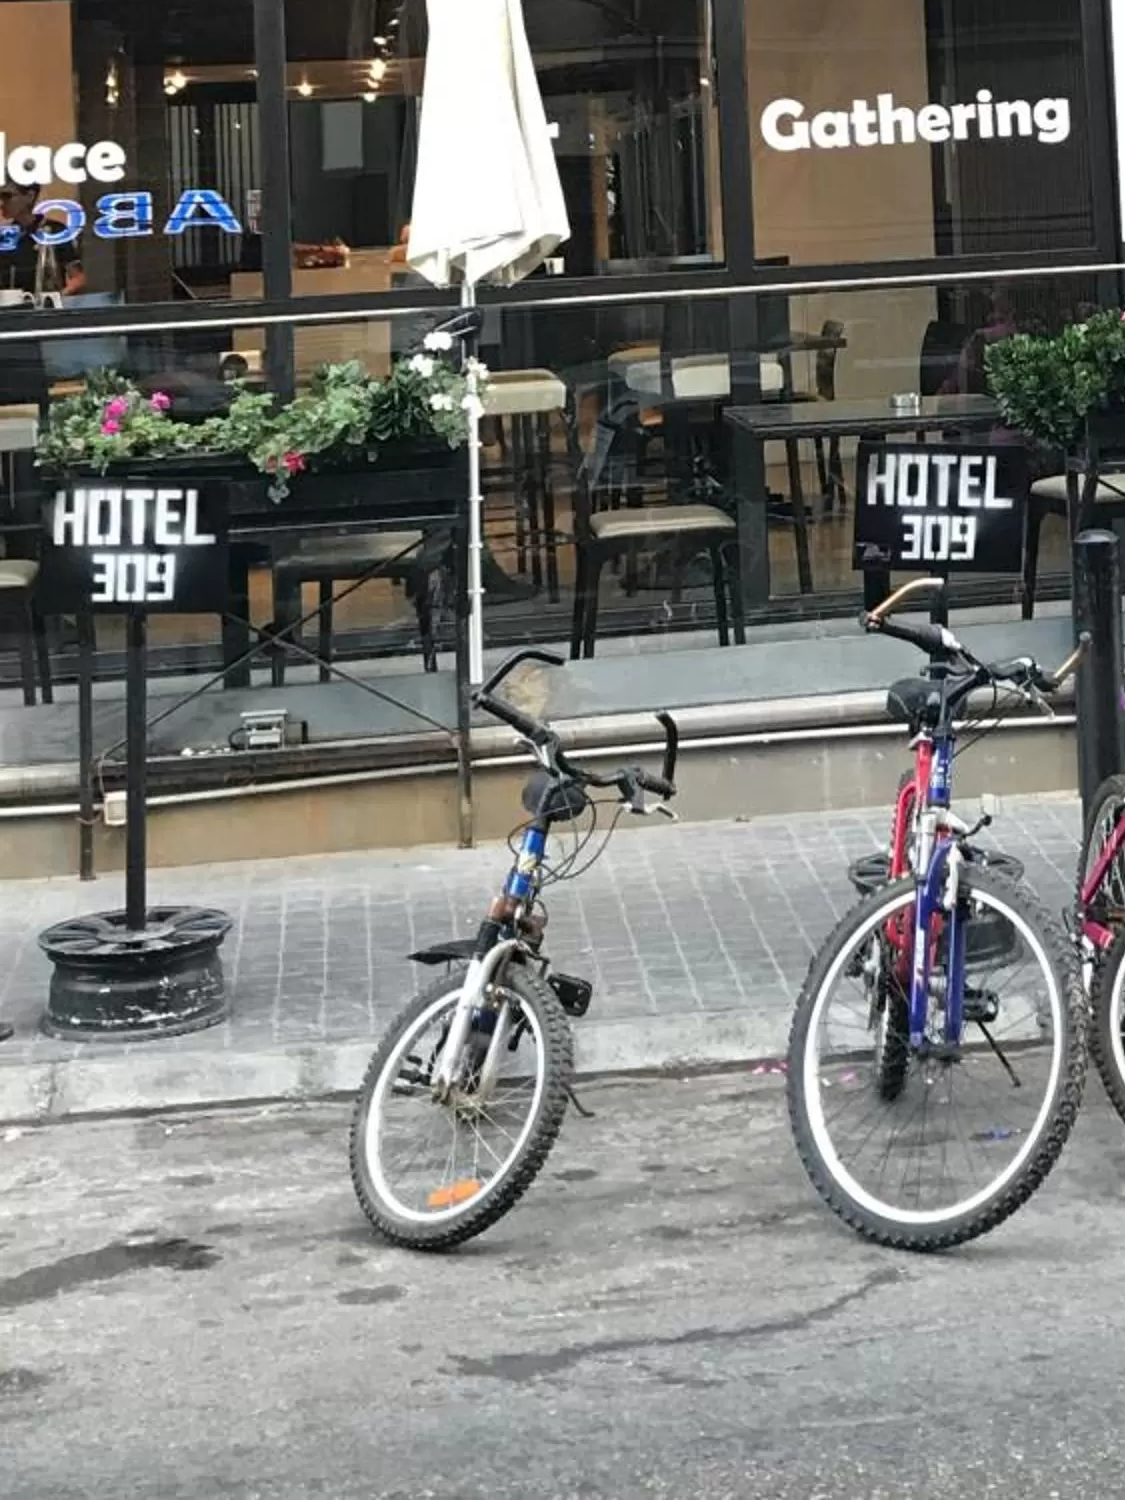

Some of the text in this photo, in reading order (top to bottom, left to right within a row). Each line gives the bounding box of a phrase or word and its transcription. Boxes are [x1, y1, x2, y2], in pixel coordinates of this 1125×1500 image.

[760, 89, 1071, 151] Gathering
[866, 453, 1015, 509] HOTEL
[53, 488, 216, 546] HOTEL
[901, 515, 977, 561] 309
[91, 553, 176, 602] 309
